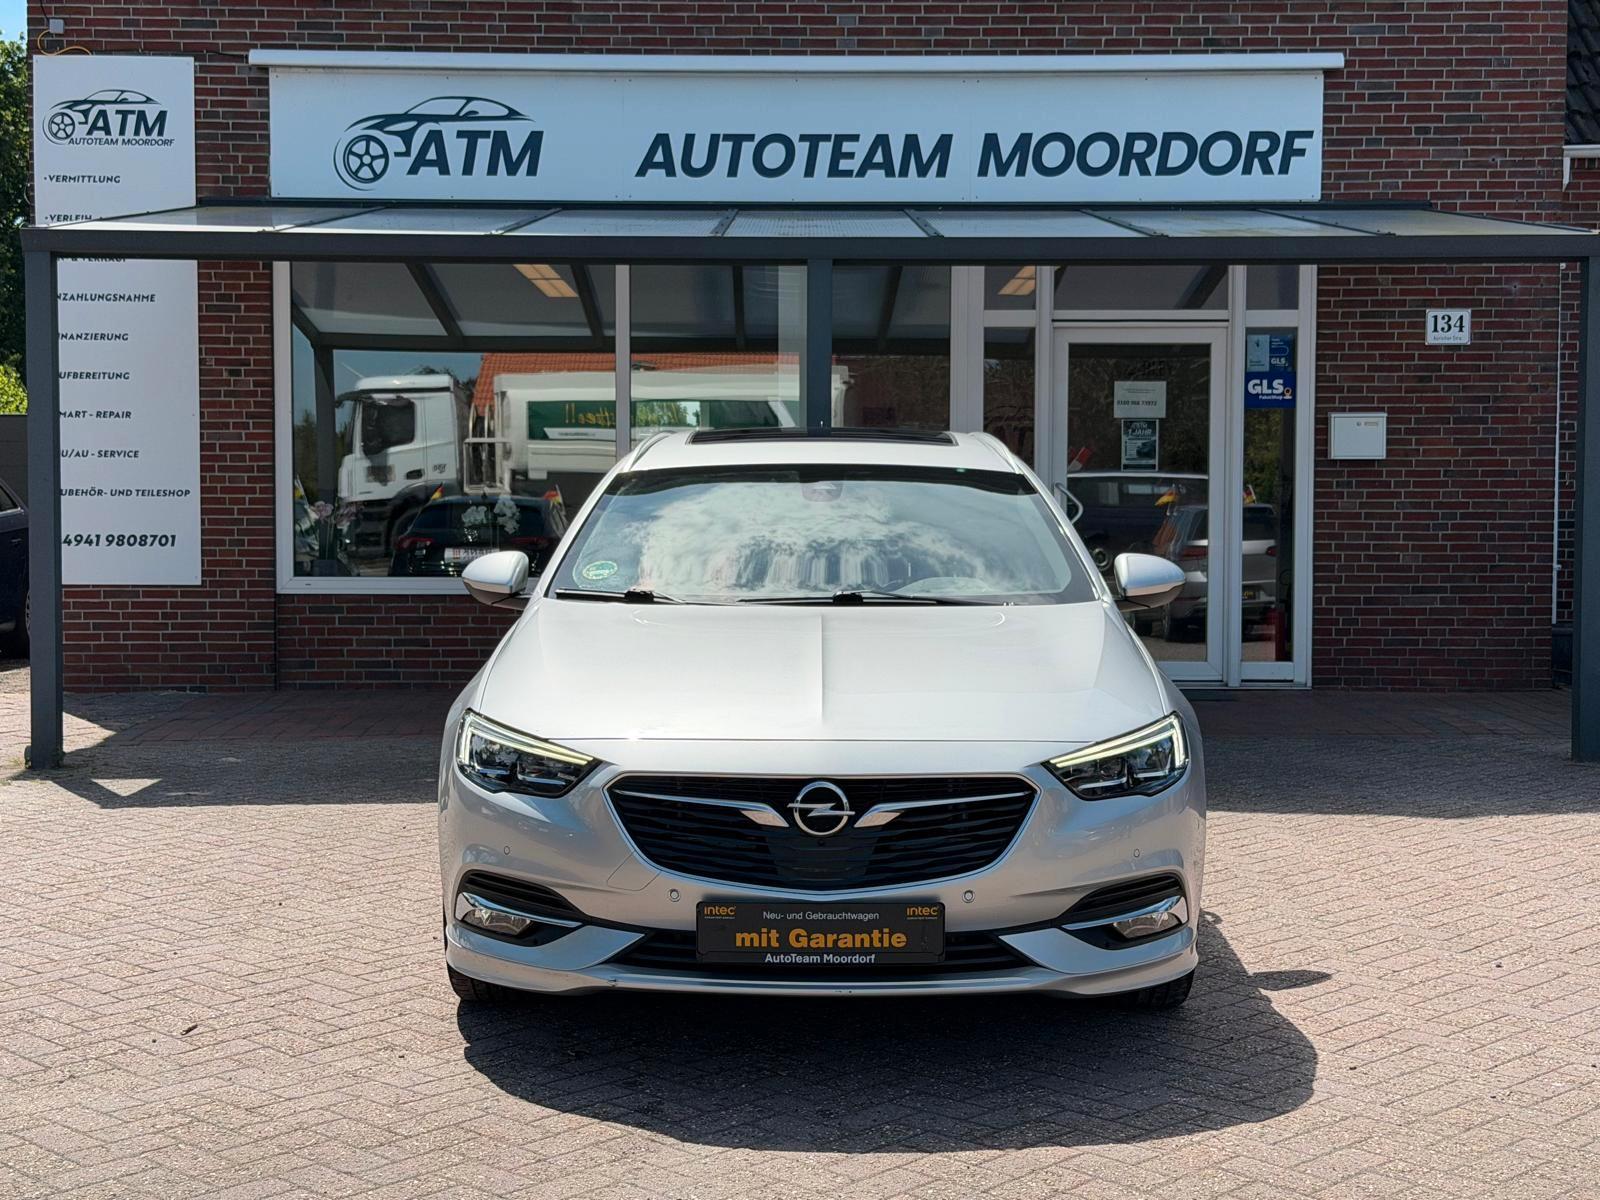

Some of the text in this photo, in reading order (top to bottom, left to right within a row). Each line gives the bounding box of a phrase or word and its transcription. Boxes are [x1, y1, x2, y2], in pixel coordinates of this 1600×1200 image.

[86, 109, 168, 137] ATM
[67, 137, 175, 148] AUTOTEAM MOORDORF
[407, 129, 545, 177] ATM
[635, 130, 1315, 179] AUTOTEAM MOORDORF
[48, 174, 121, 184] VERMITTLUNG
[1432, 314, 1465, 334] 134
[1247, 379, 1284, 395] GLS
[95, 410, 132, 420] REPAIR
[97, 449, 140, 459] SERVICE
[110, 488, 133, 497] UND
[135, 488, 191, 498] TEILESHOP
[63, 533, 177, 548] 4941 9808701
[703, 905, 737, 916] intec
[906, 906, 939, 917] intec
[762, 911, 880, 922] Neu- und Gebrauchtwagen
[735, 927, 908, 949] mit Garantie
[764, 953, 876, 965] AutoTeam Moordorf
